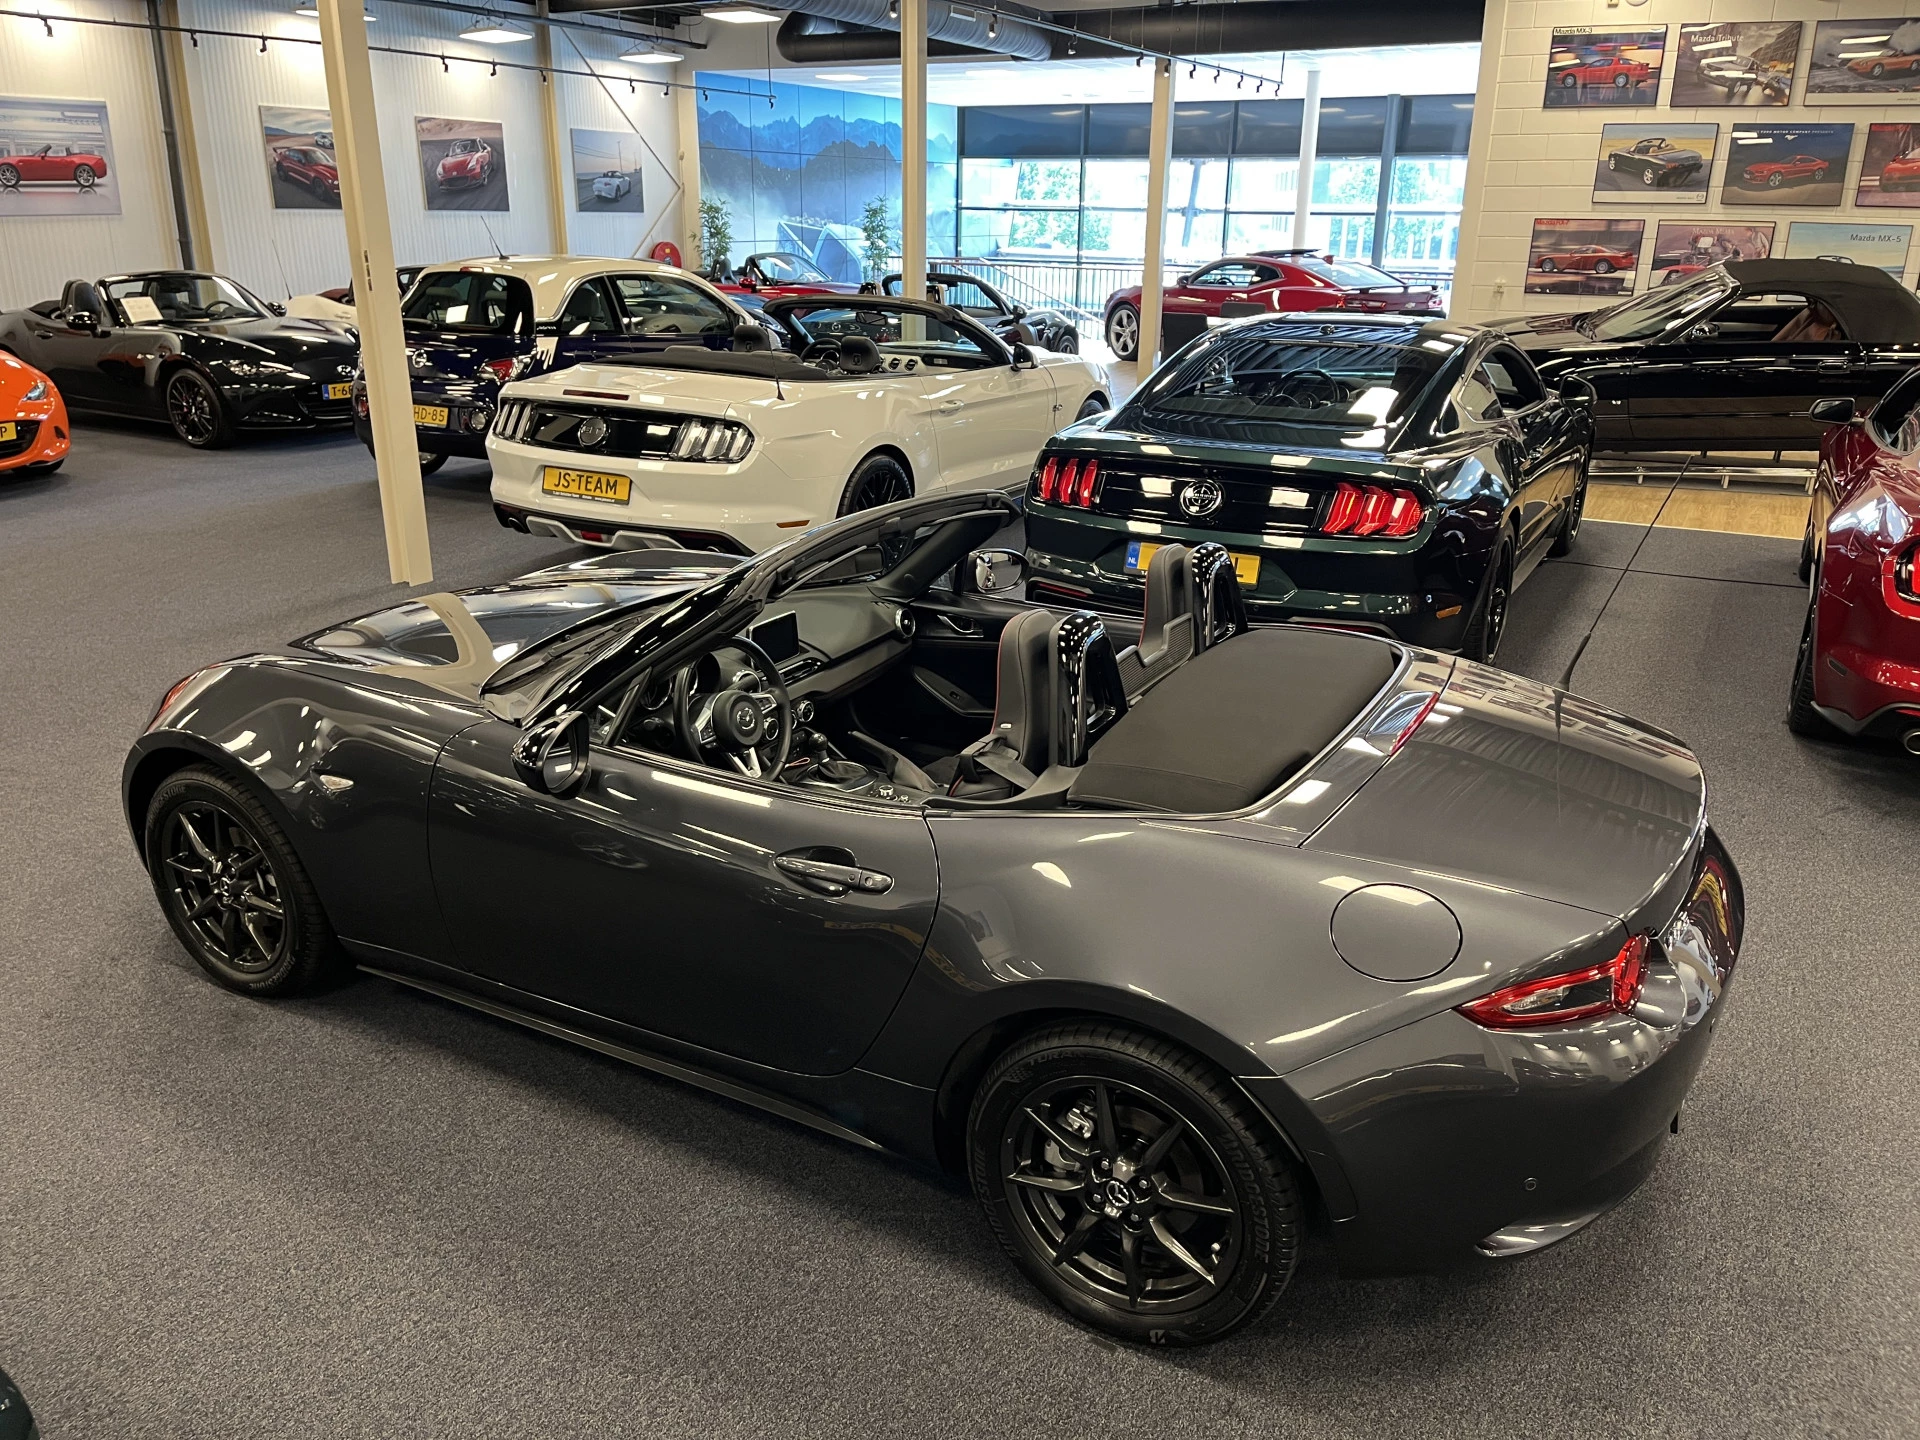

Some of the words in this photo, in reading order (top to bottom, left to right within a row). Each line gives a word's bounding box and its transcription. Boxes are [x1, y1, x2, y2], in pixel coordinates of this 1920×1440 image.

[1691, 34, 1715, 42] Mazda
[1717, 34, 1744, 42] Tribute
[1850, 233, 1876, 242] Mazda
[1878, 234, 1902, 243] MX-5
[553, 471, 618, 496] JS-TEAM
[1128, 557, 1137, 565] NL
